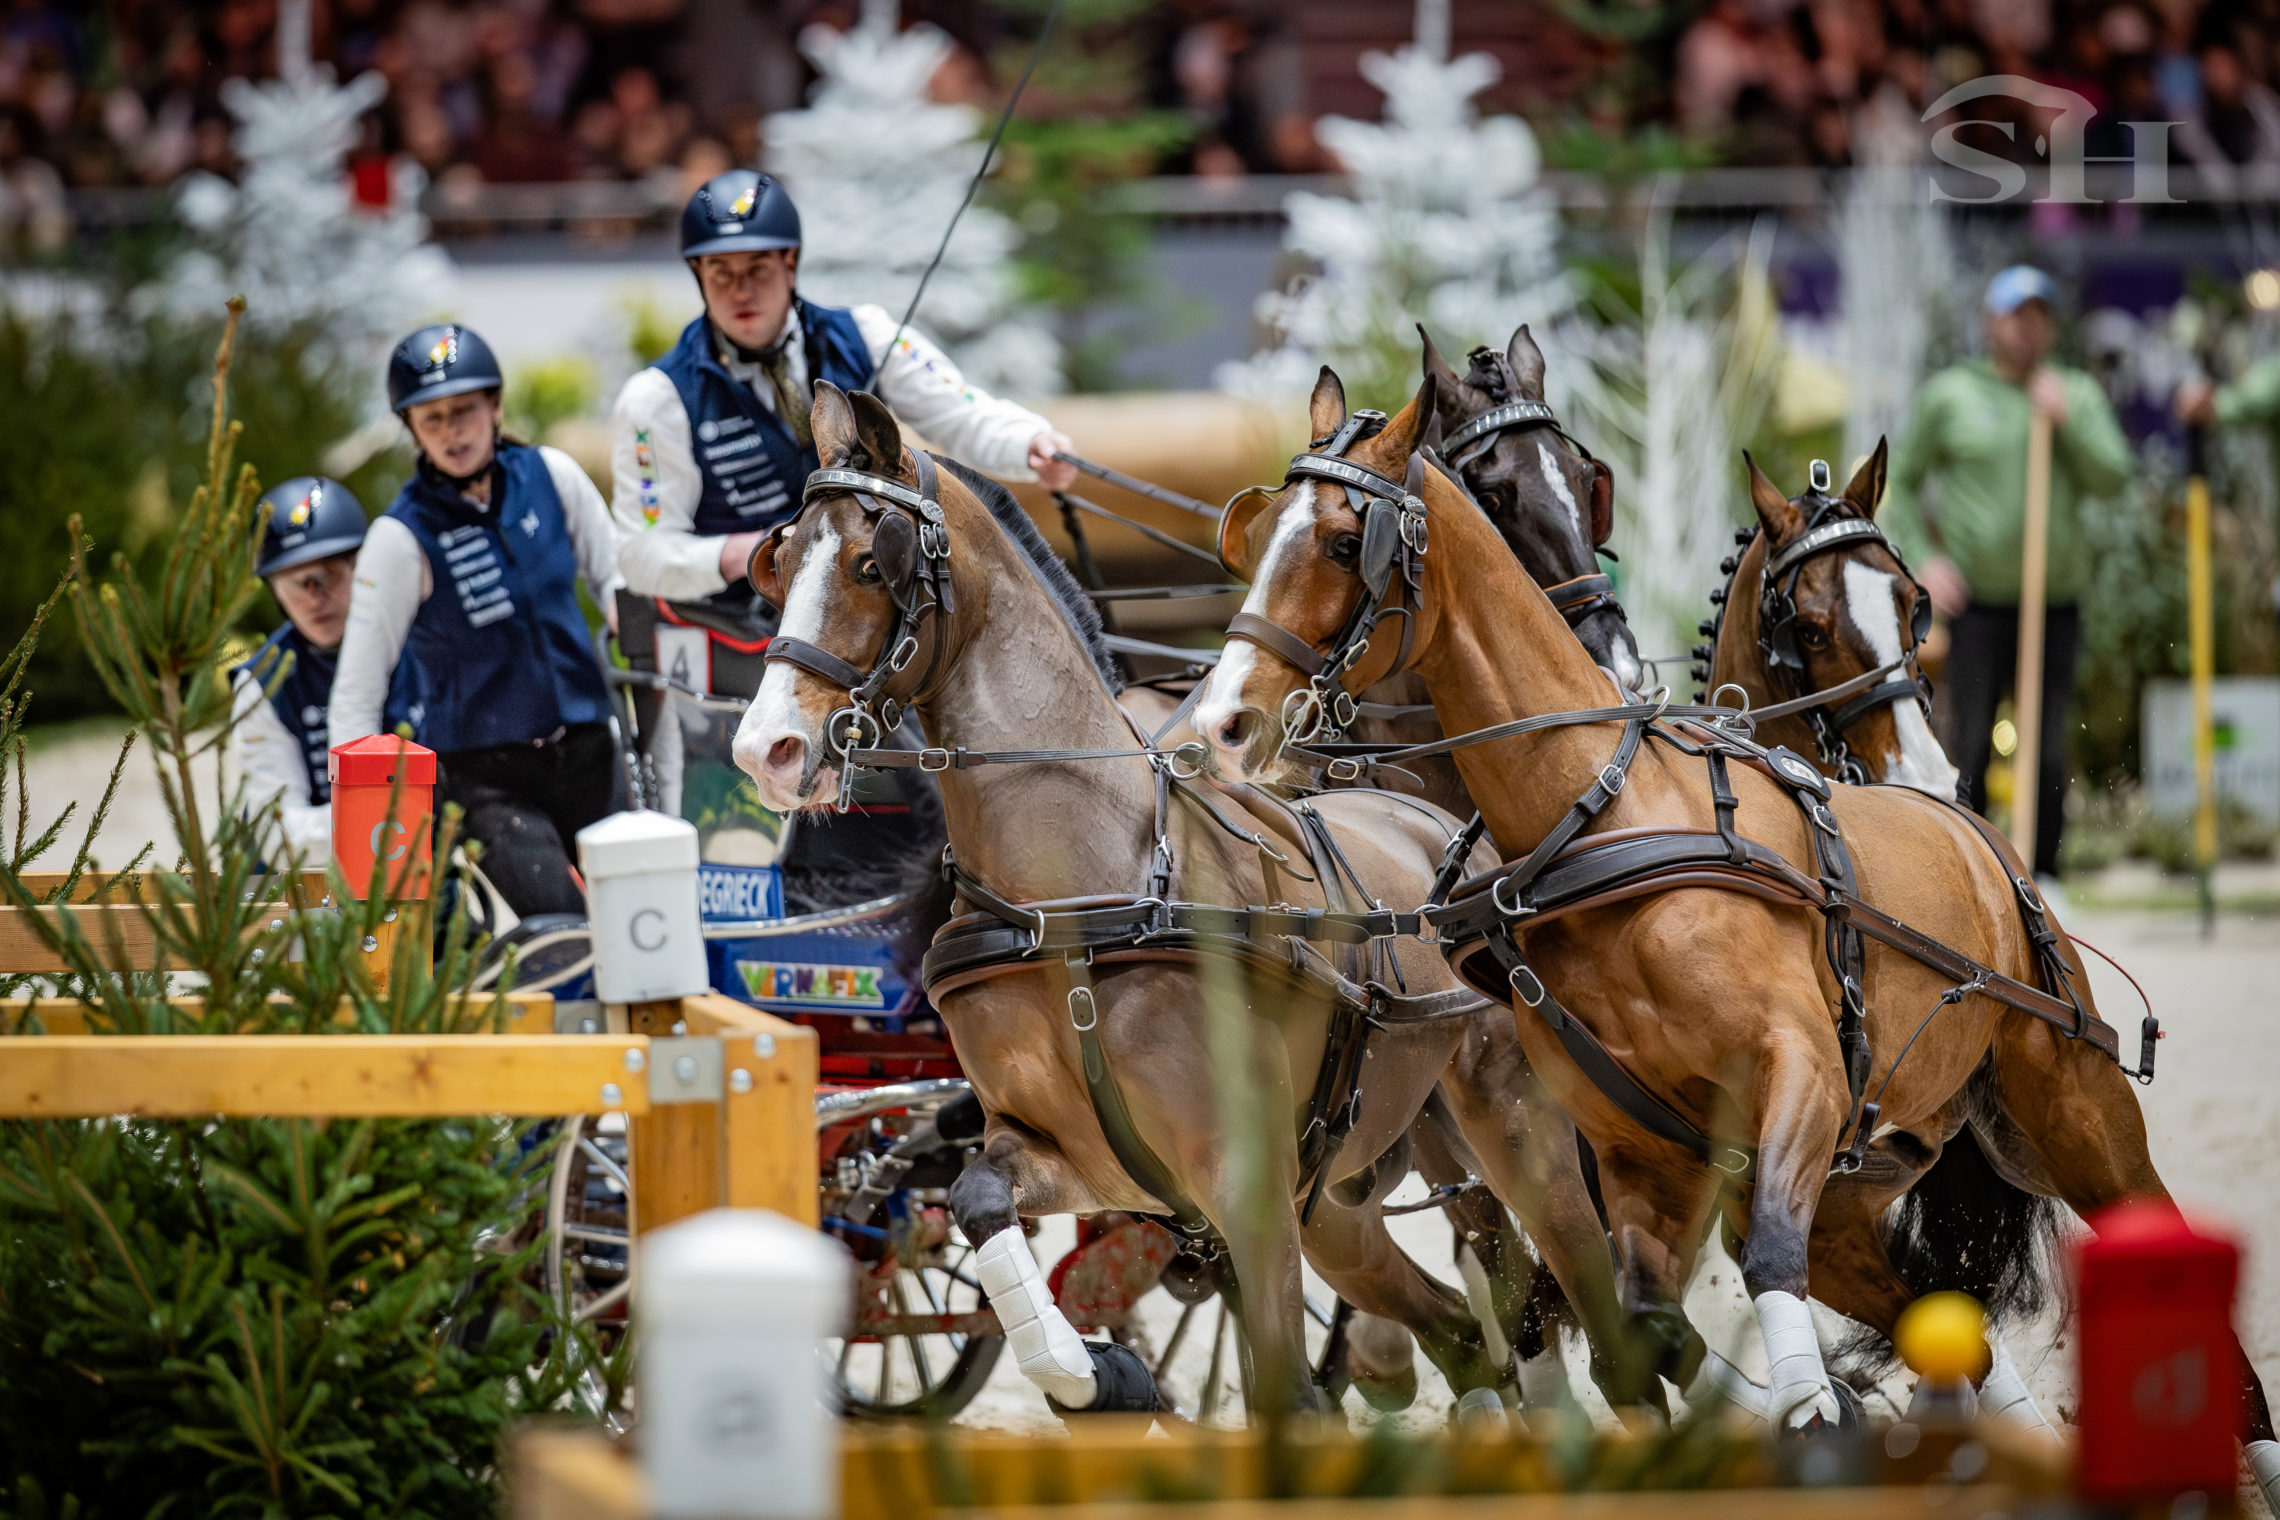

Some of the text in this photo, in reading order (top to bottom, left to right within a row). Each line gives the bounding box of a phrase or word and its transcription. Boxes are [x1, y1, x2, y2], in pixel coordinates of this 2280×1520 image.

[370, 820, 407, 861] C
[698, 871, 770, 917] EGRIECK
[629, 906, 669, 953] C
